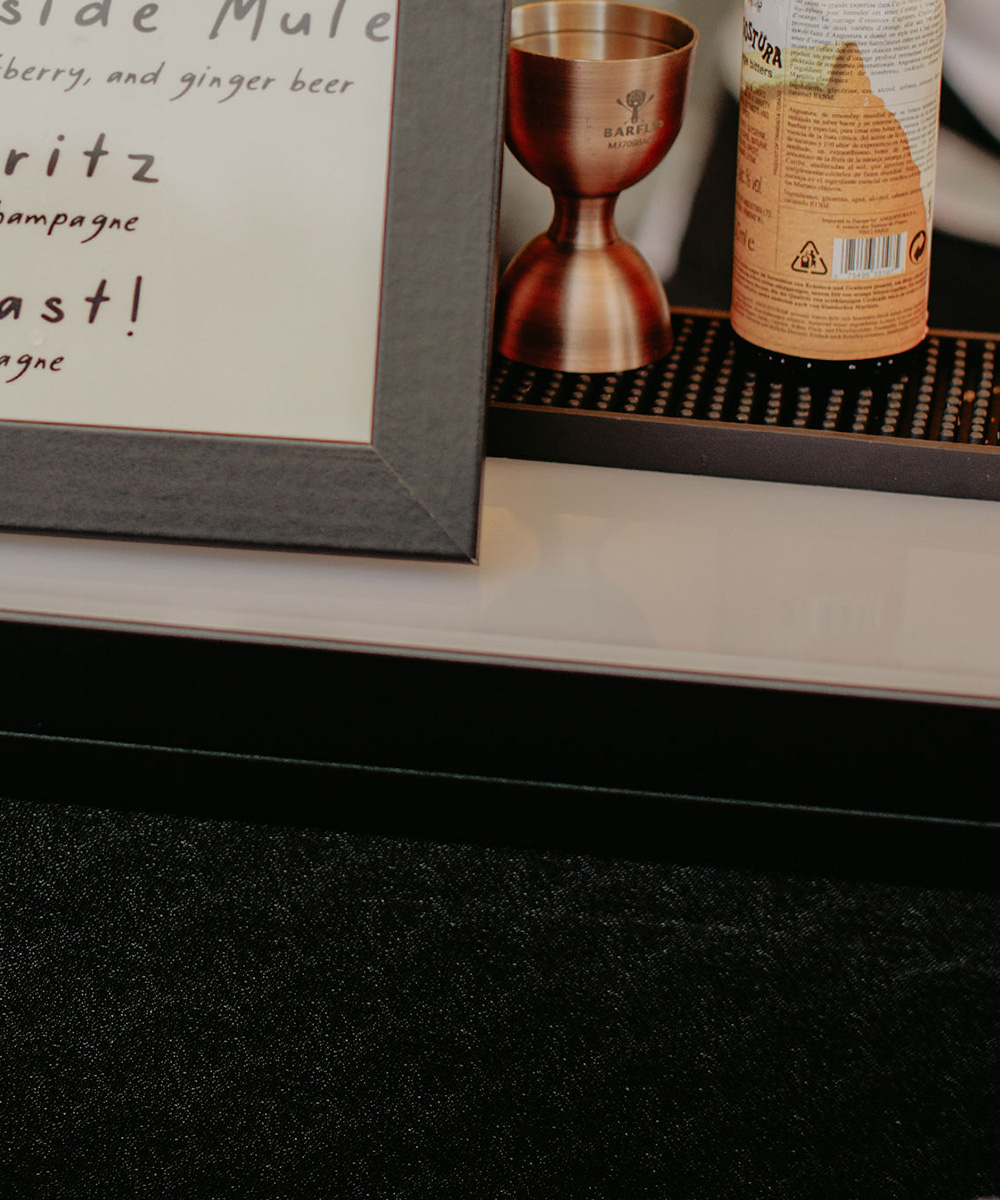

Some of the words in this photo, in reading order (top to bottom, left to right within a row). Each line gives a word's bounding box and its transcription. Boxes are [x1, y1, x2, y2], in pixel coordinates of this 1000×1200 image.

[106, 61, 165, 85] and
[169, 72, 276, 104] ginger
[289, 67, 354, 94] beer
